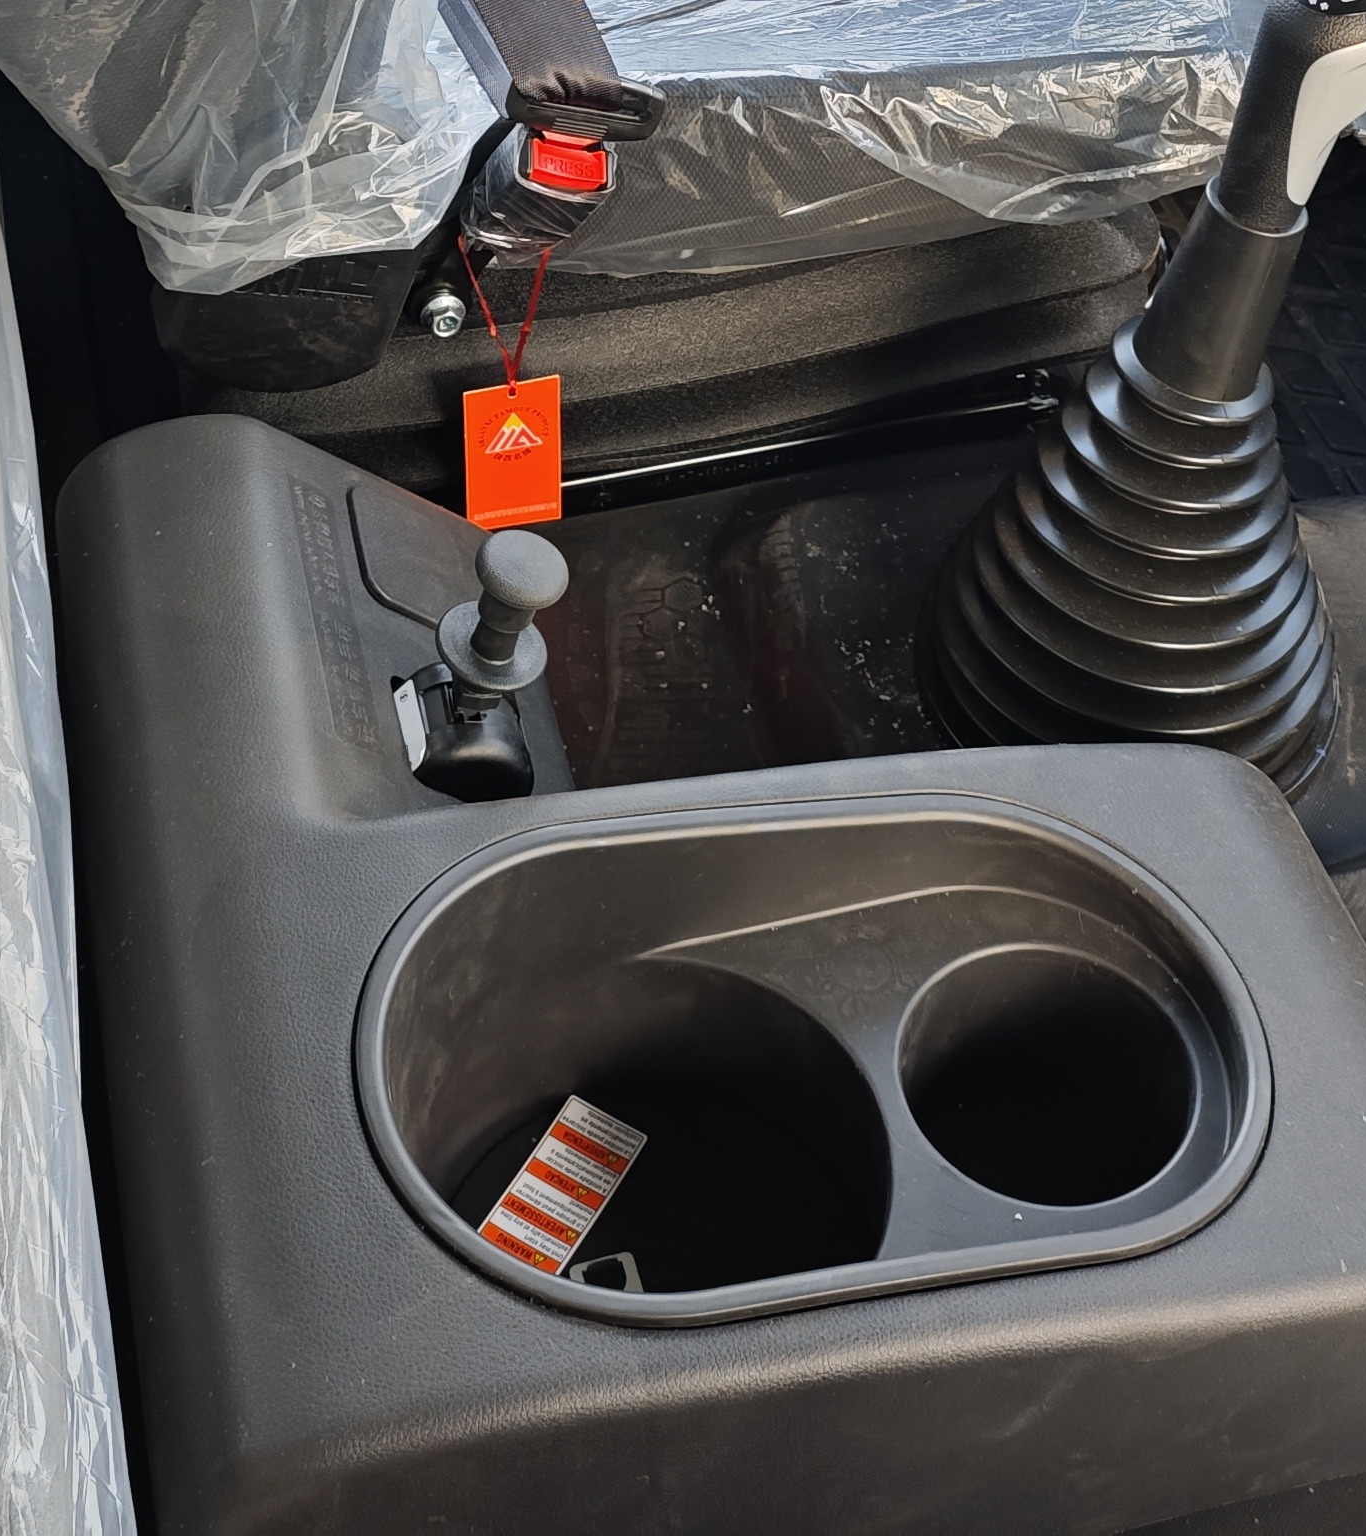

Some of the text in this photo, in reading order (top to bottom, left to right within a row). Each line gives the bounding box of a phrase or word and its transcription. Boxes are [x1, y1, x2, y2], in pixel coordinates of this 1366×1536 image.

[543, 156, 595, 179] PRESS
[541, 1168, 577, 1193] ATENÇÃO
[498, 1210, 513, 1220] time
[502, 1196, 567, 1236] AVERTISSEMENT
[512, 1216, 524, 1226] any
[493, 1232, 535, 1260] WARNING
[522, 1234, 564, 1259] Unit may start
[529, 1226, 569, 1252] automatically
